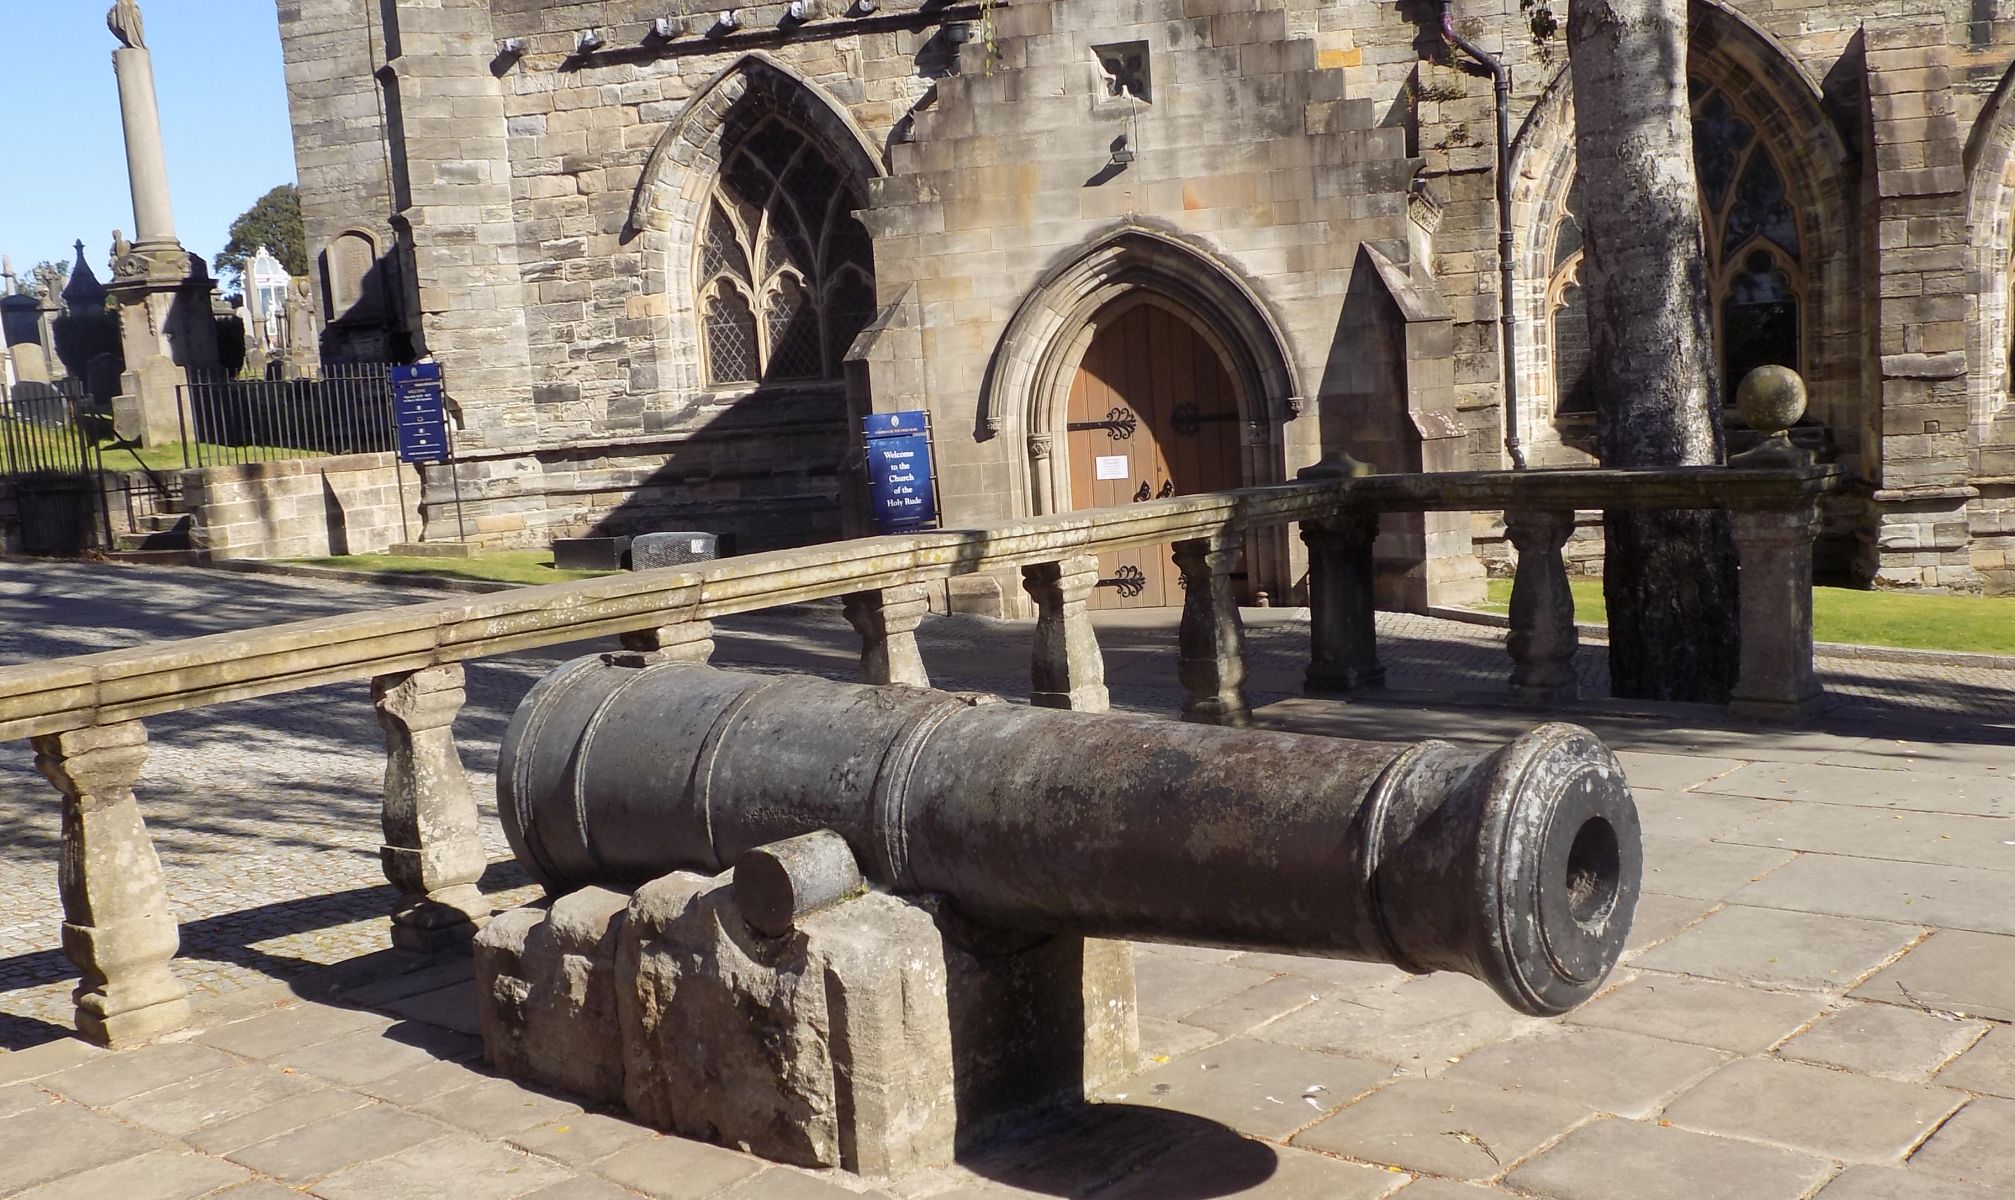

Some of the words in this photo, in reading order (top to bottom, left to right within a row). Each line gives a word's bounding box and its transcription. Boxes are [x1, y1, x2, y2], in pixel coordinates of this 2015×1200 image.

[884, 450, 914, 459] Welcome
[899, 462, 910, 470] the
[889, 472, 914, 482] Church
[894, 486, 901, 494] of
[902, 485, 913, 494] the
[887, 499, 903, 508] Holy
[904, 497, 922, 506] Rude
